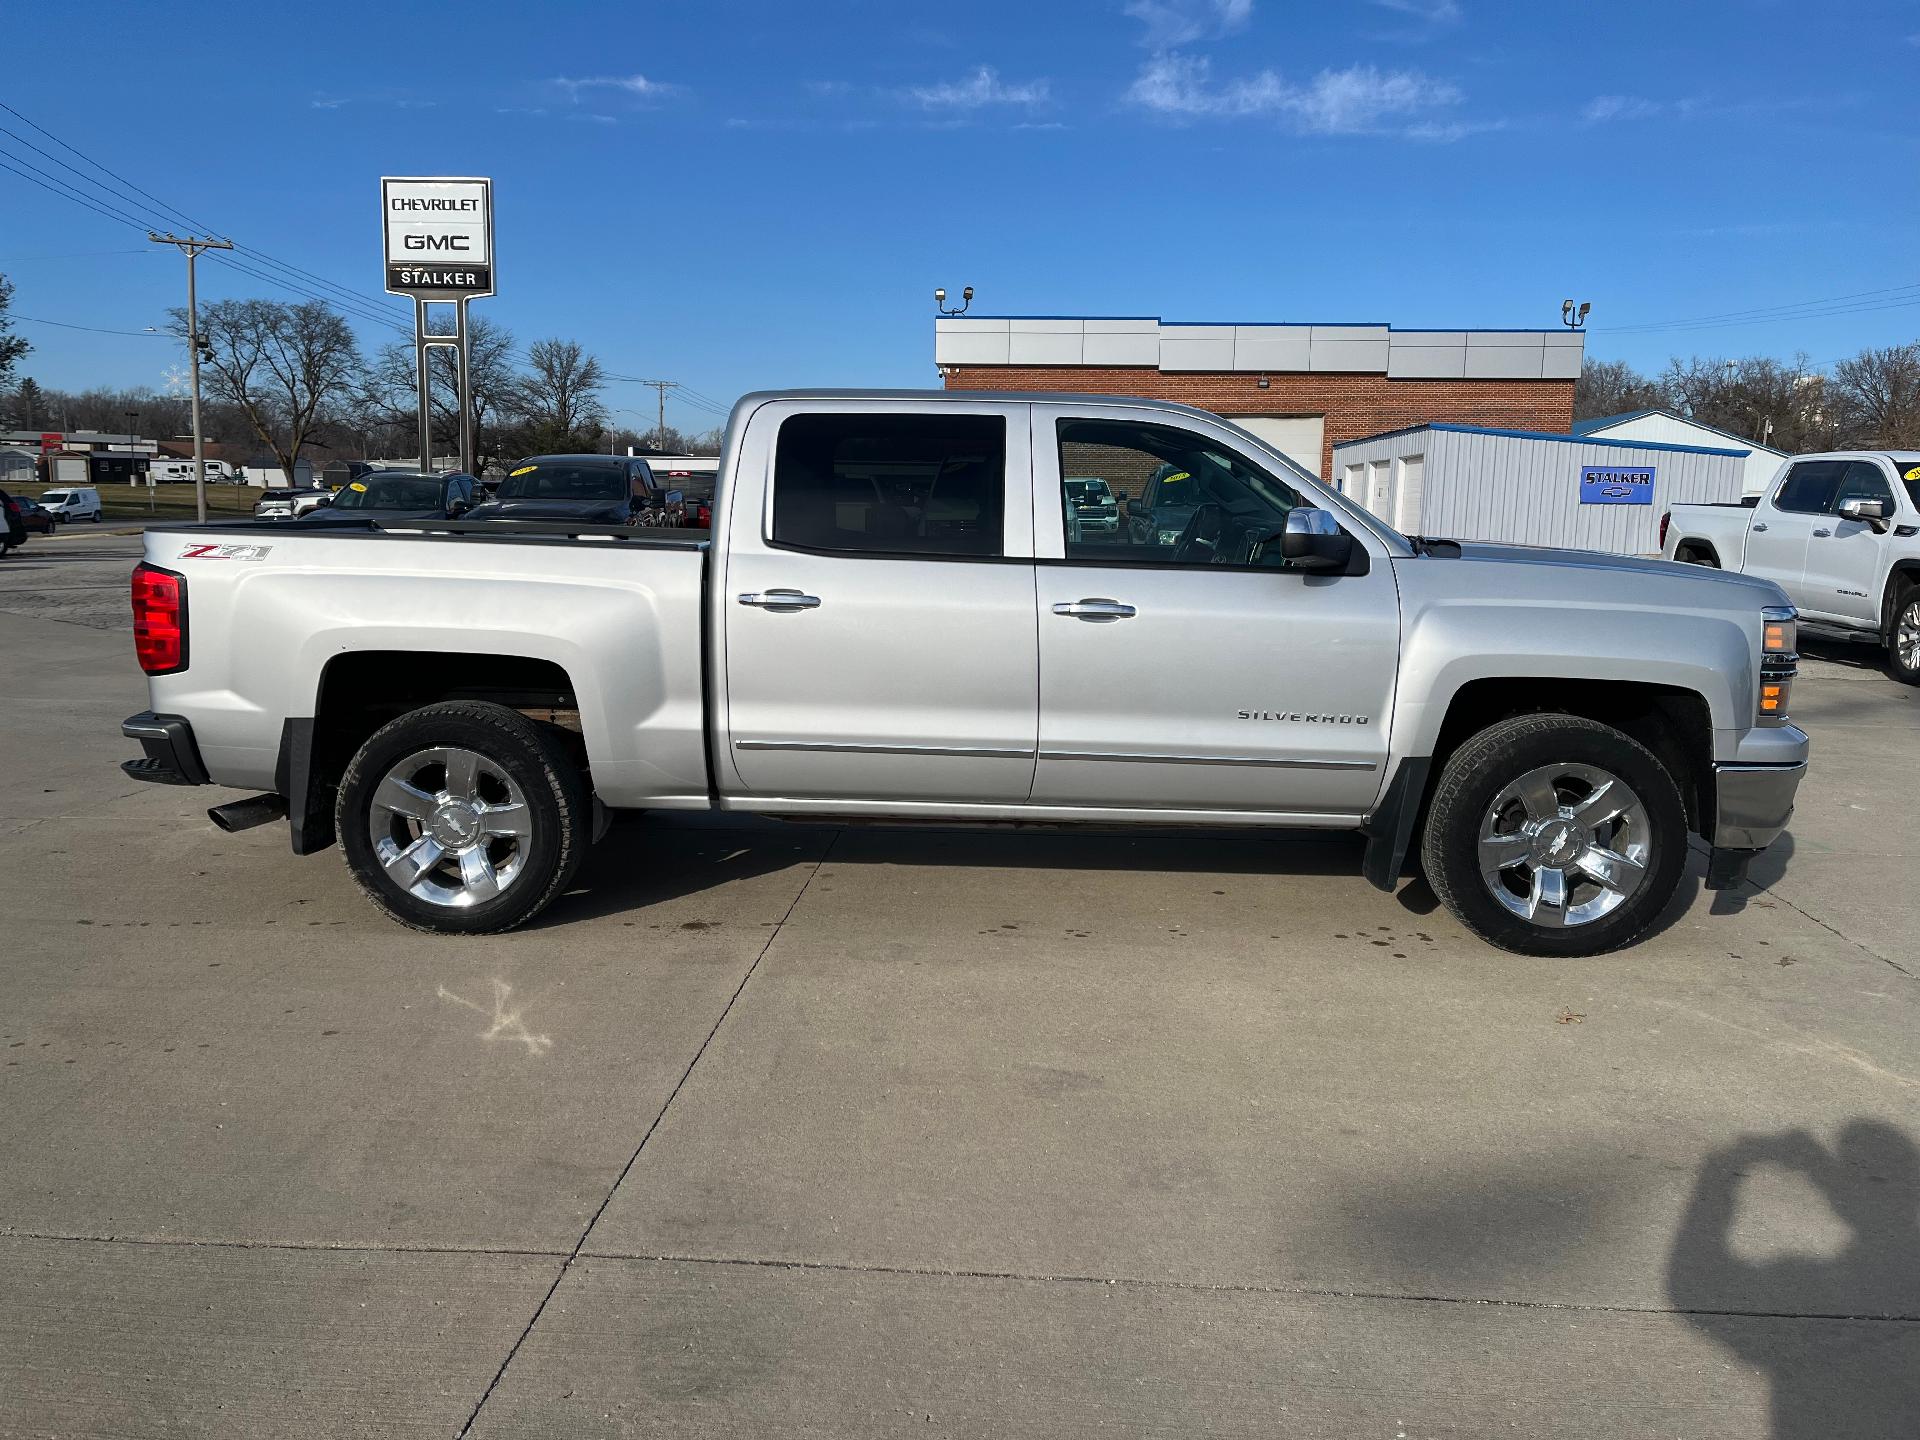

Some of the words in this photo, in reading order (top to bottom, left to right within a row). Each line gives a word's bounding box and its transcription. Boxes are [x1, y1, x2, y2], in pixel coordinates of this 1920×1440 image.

[392, 198, 479, 211] CHEVROLET
[404, 234, 470, 251] GMC
[401, 271, 476, 285] STALKER
[1586, 472, 1651, 485] STALKER
[177, 542, 274, 562] Z71
[1237, 709, 1369, 725] SILVERADO
